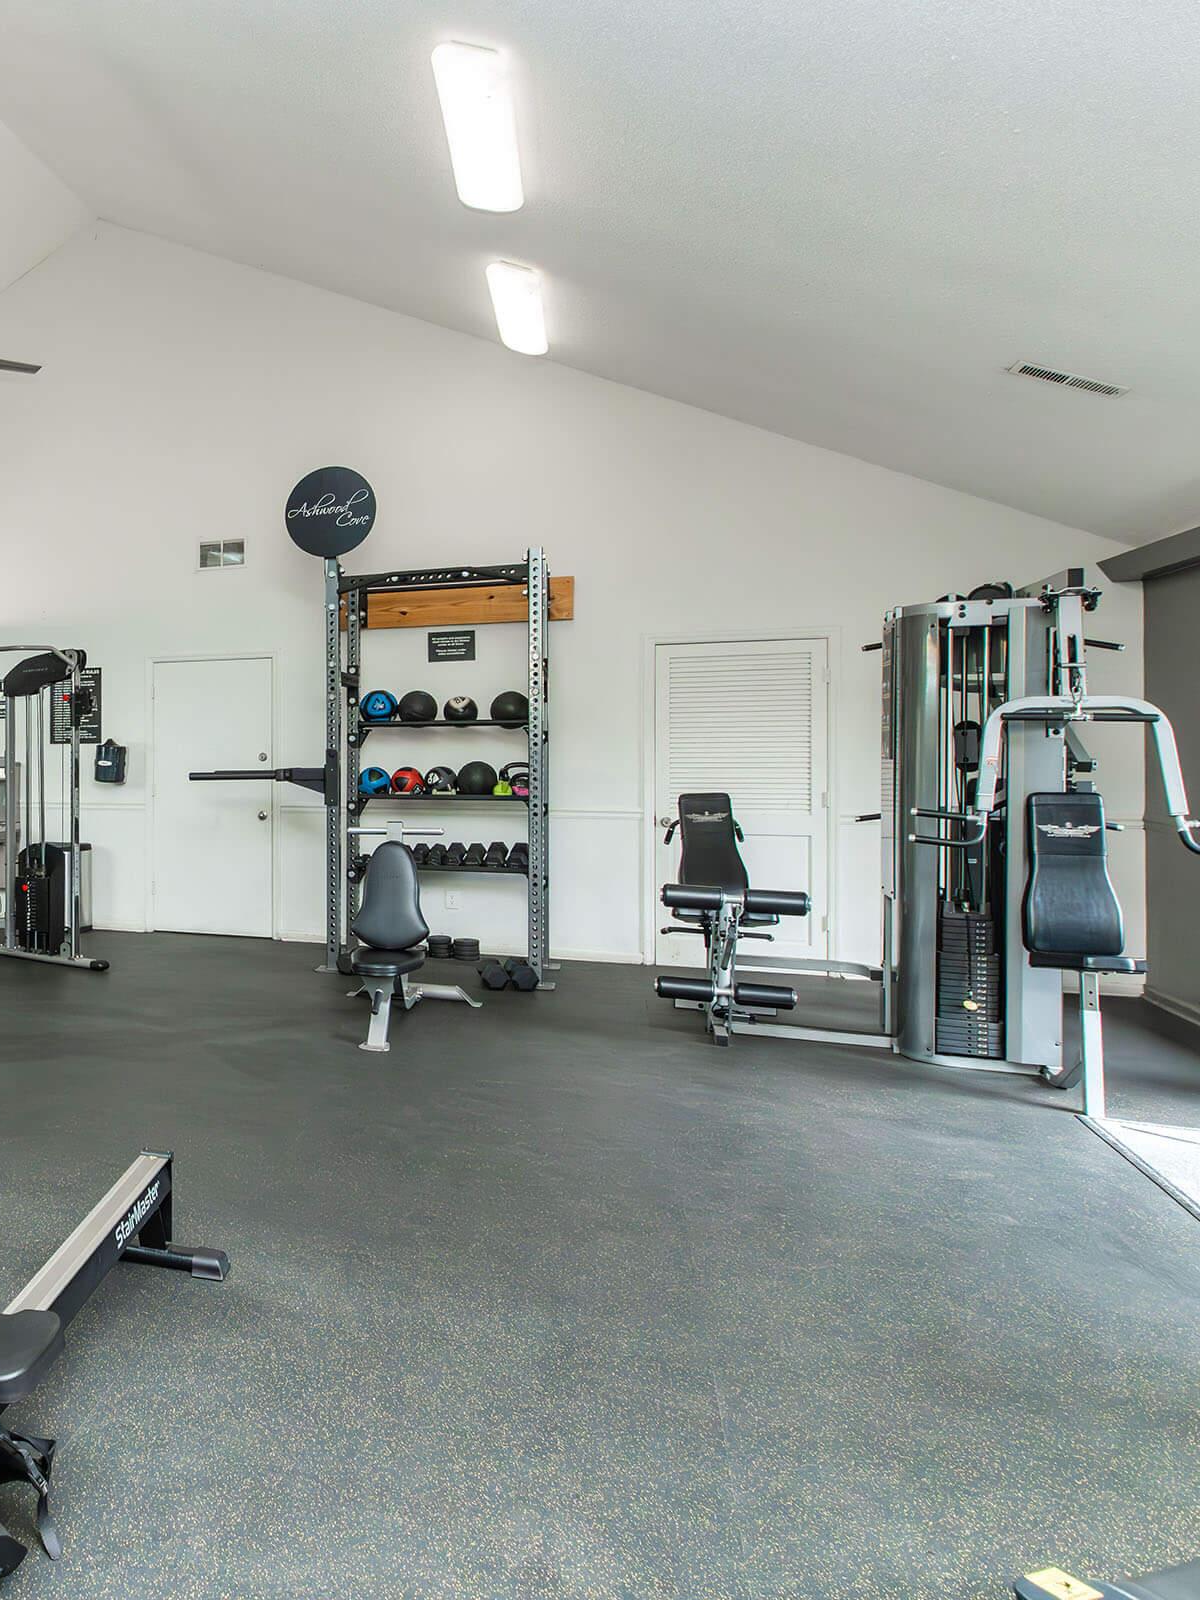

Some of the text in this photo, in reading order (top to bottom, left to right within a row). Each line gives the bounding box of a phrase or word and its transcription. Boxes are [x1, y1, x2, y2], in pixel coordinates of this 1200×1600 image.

[288, 488, 369, 519] Ashwood
[335, 511, 370, 527] Cove
[115, 1181, 160, 1250] StairMaster
